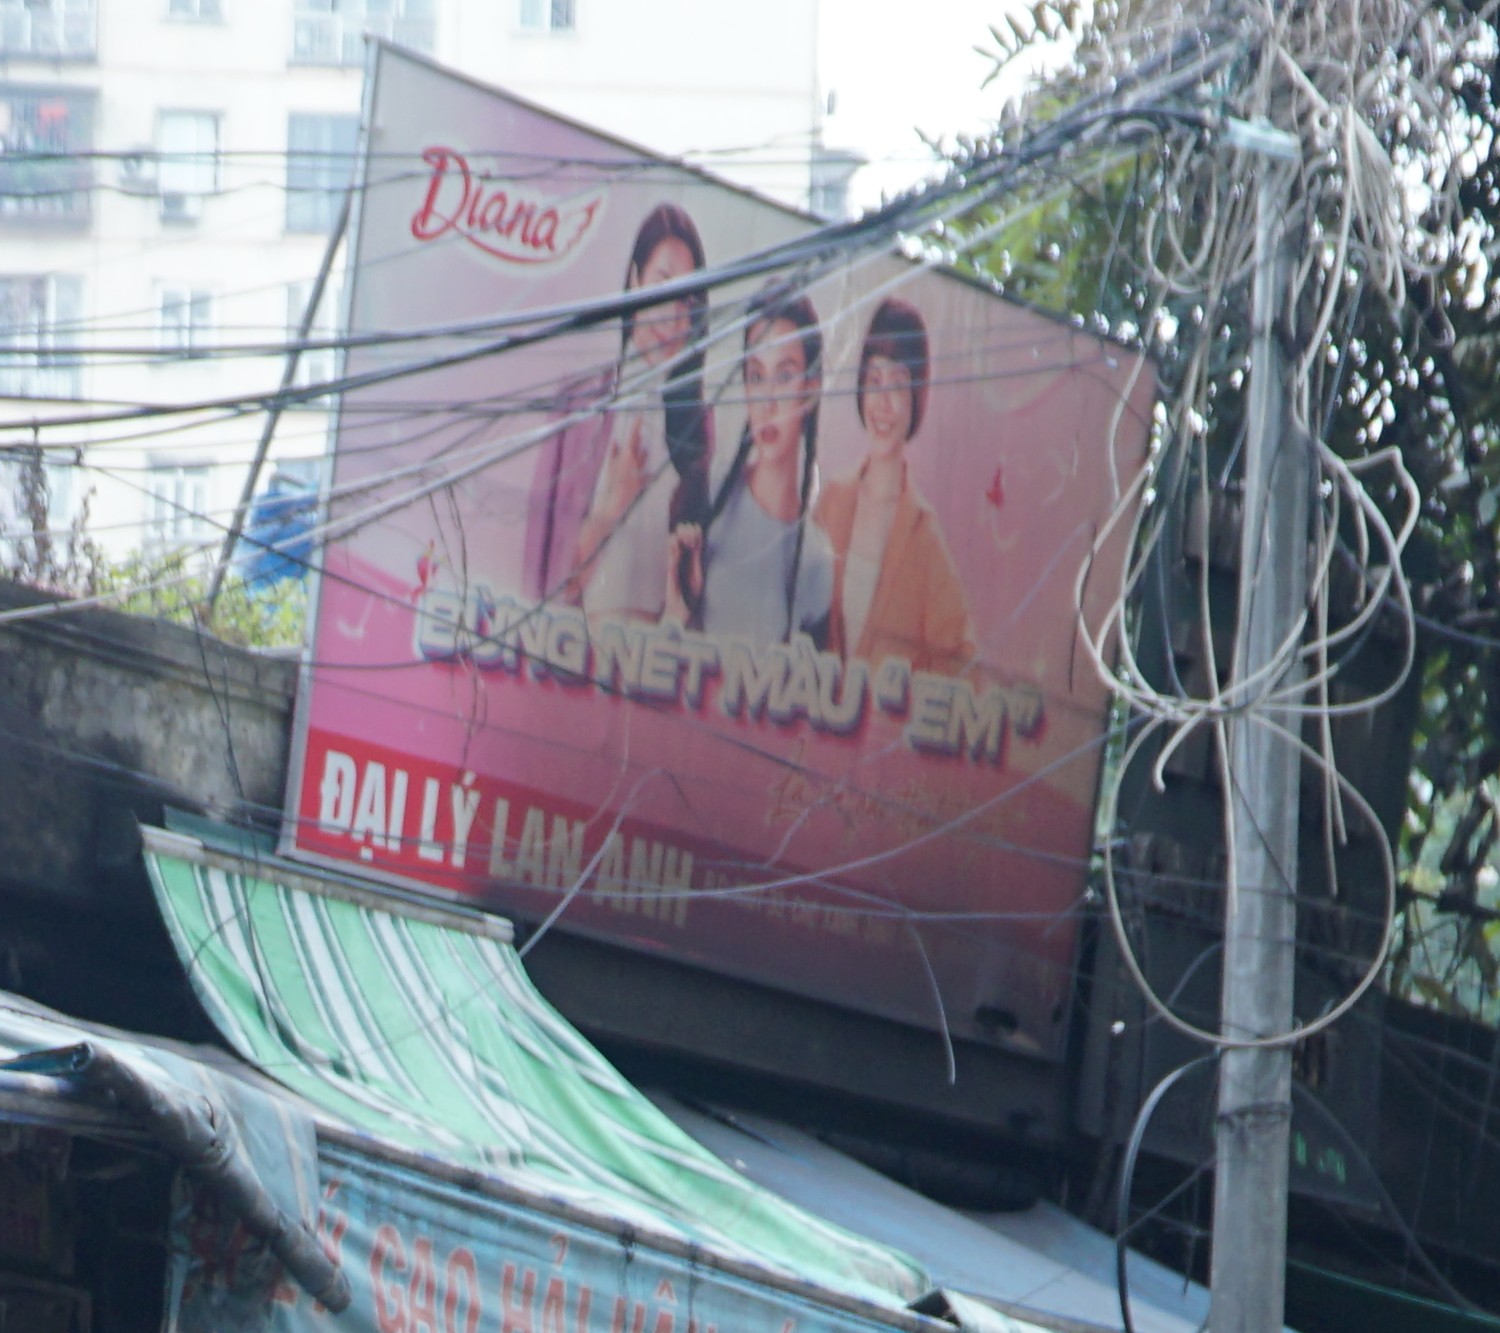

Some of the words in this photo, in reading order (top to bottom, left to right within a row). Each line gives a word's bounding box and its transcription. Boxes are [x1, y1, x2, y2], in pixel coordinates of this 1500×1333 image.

[411, 146, 575, 262] Diana
[318, 748, 408, 862] ĐẠI
[417, 770, 481, 869] LÝ
[488, 797, 586, 893] LAN
[592, 832, 693, 928] ANH
